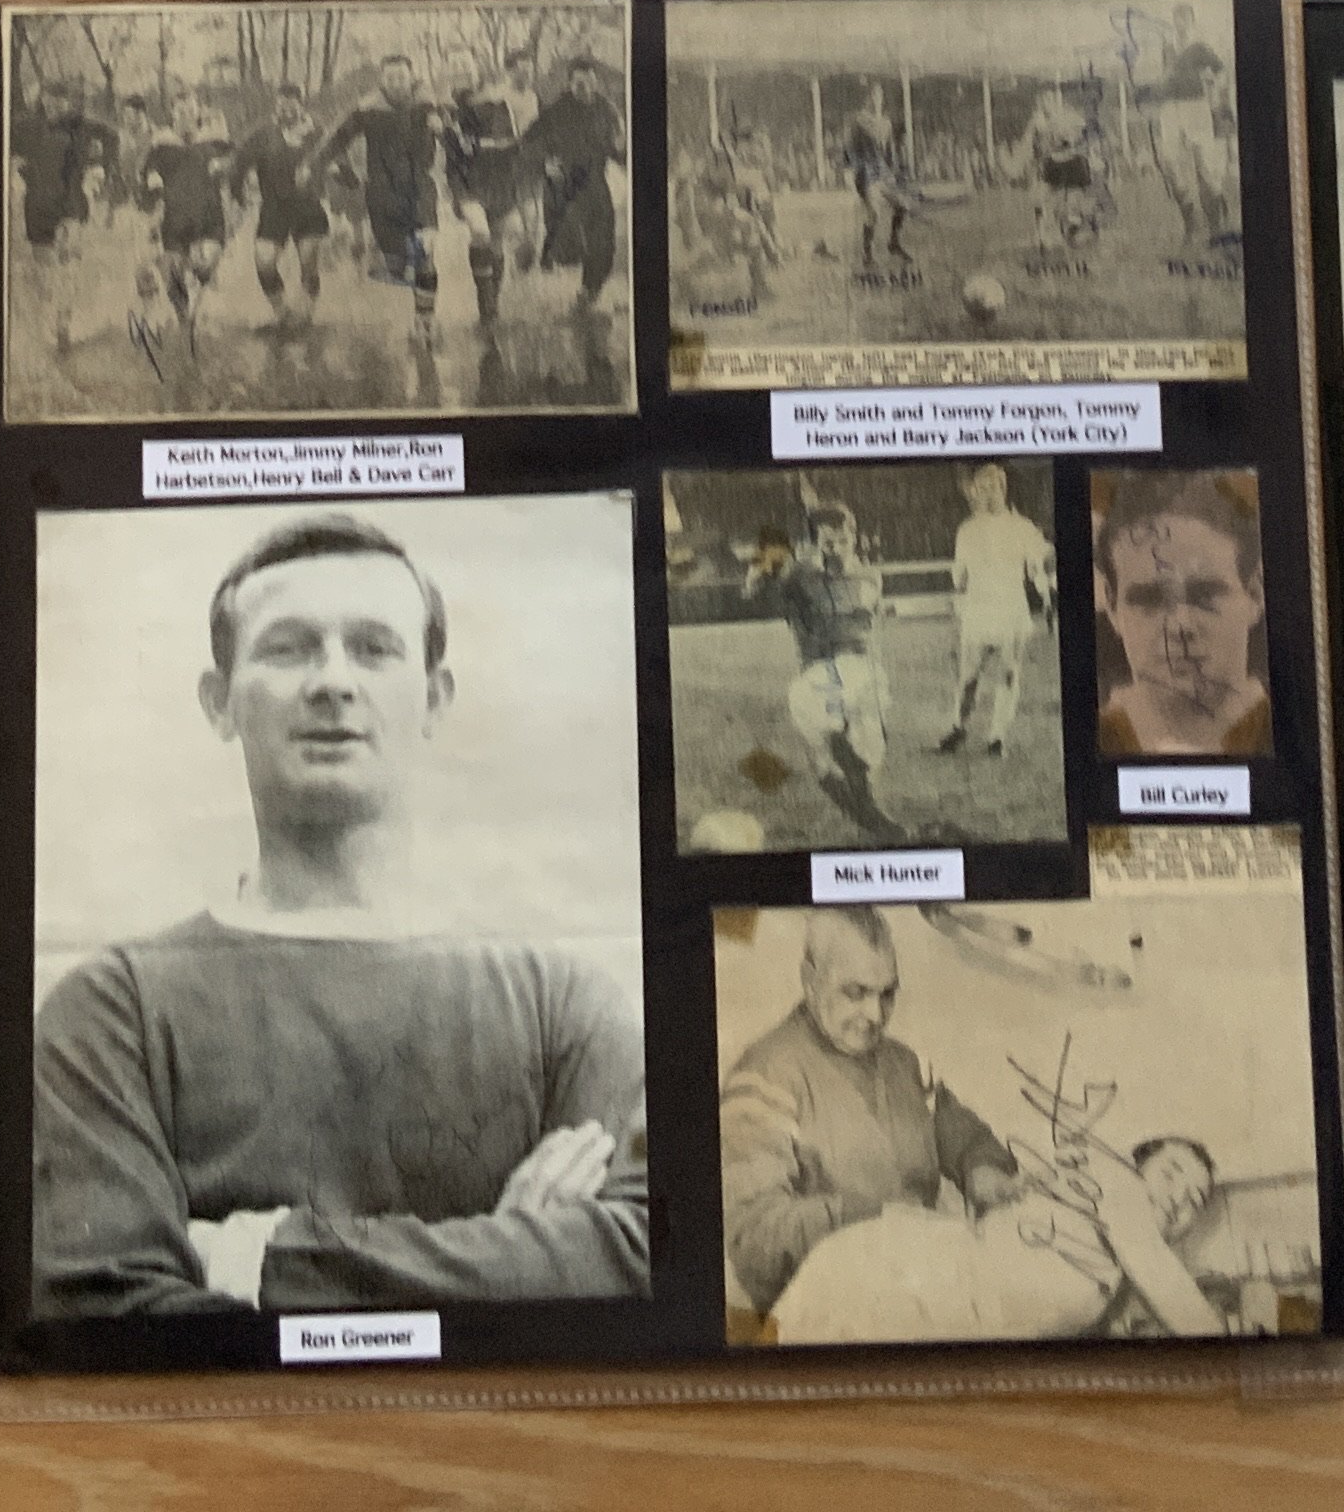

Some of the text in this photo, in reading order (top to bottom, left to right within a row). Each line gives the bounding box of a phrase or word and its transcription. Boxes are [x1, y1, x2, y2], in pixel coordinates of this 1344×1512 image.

[793, 403, 829, 424] Billy
[836, 403, 886, 423] Smith
[891, 402, 923, 422] and
[929, 401, 995, 426] Tommy
[1076, 399, 1140, 423] Tommy
[806, 423, 1128, 449] Heron and Barry Jackson (York City)
[168, 446, 215, 465] Keith
[311, 467, 343, 486] Bell
[348, 467, 363, 485] &
[368, 466, 413, 485] Dave
[419, 464, 454, 484] Carr
[1140, 784, 1228, 807] Bill Curley
[835, 864, 940, 884] Mick Hunter
[301, 1328, 414, 1349] Ron Greener
